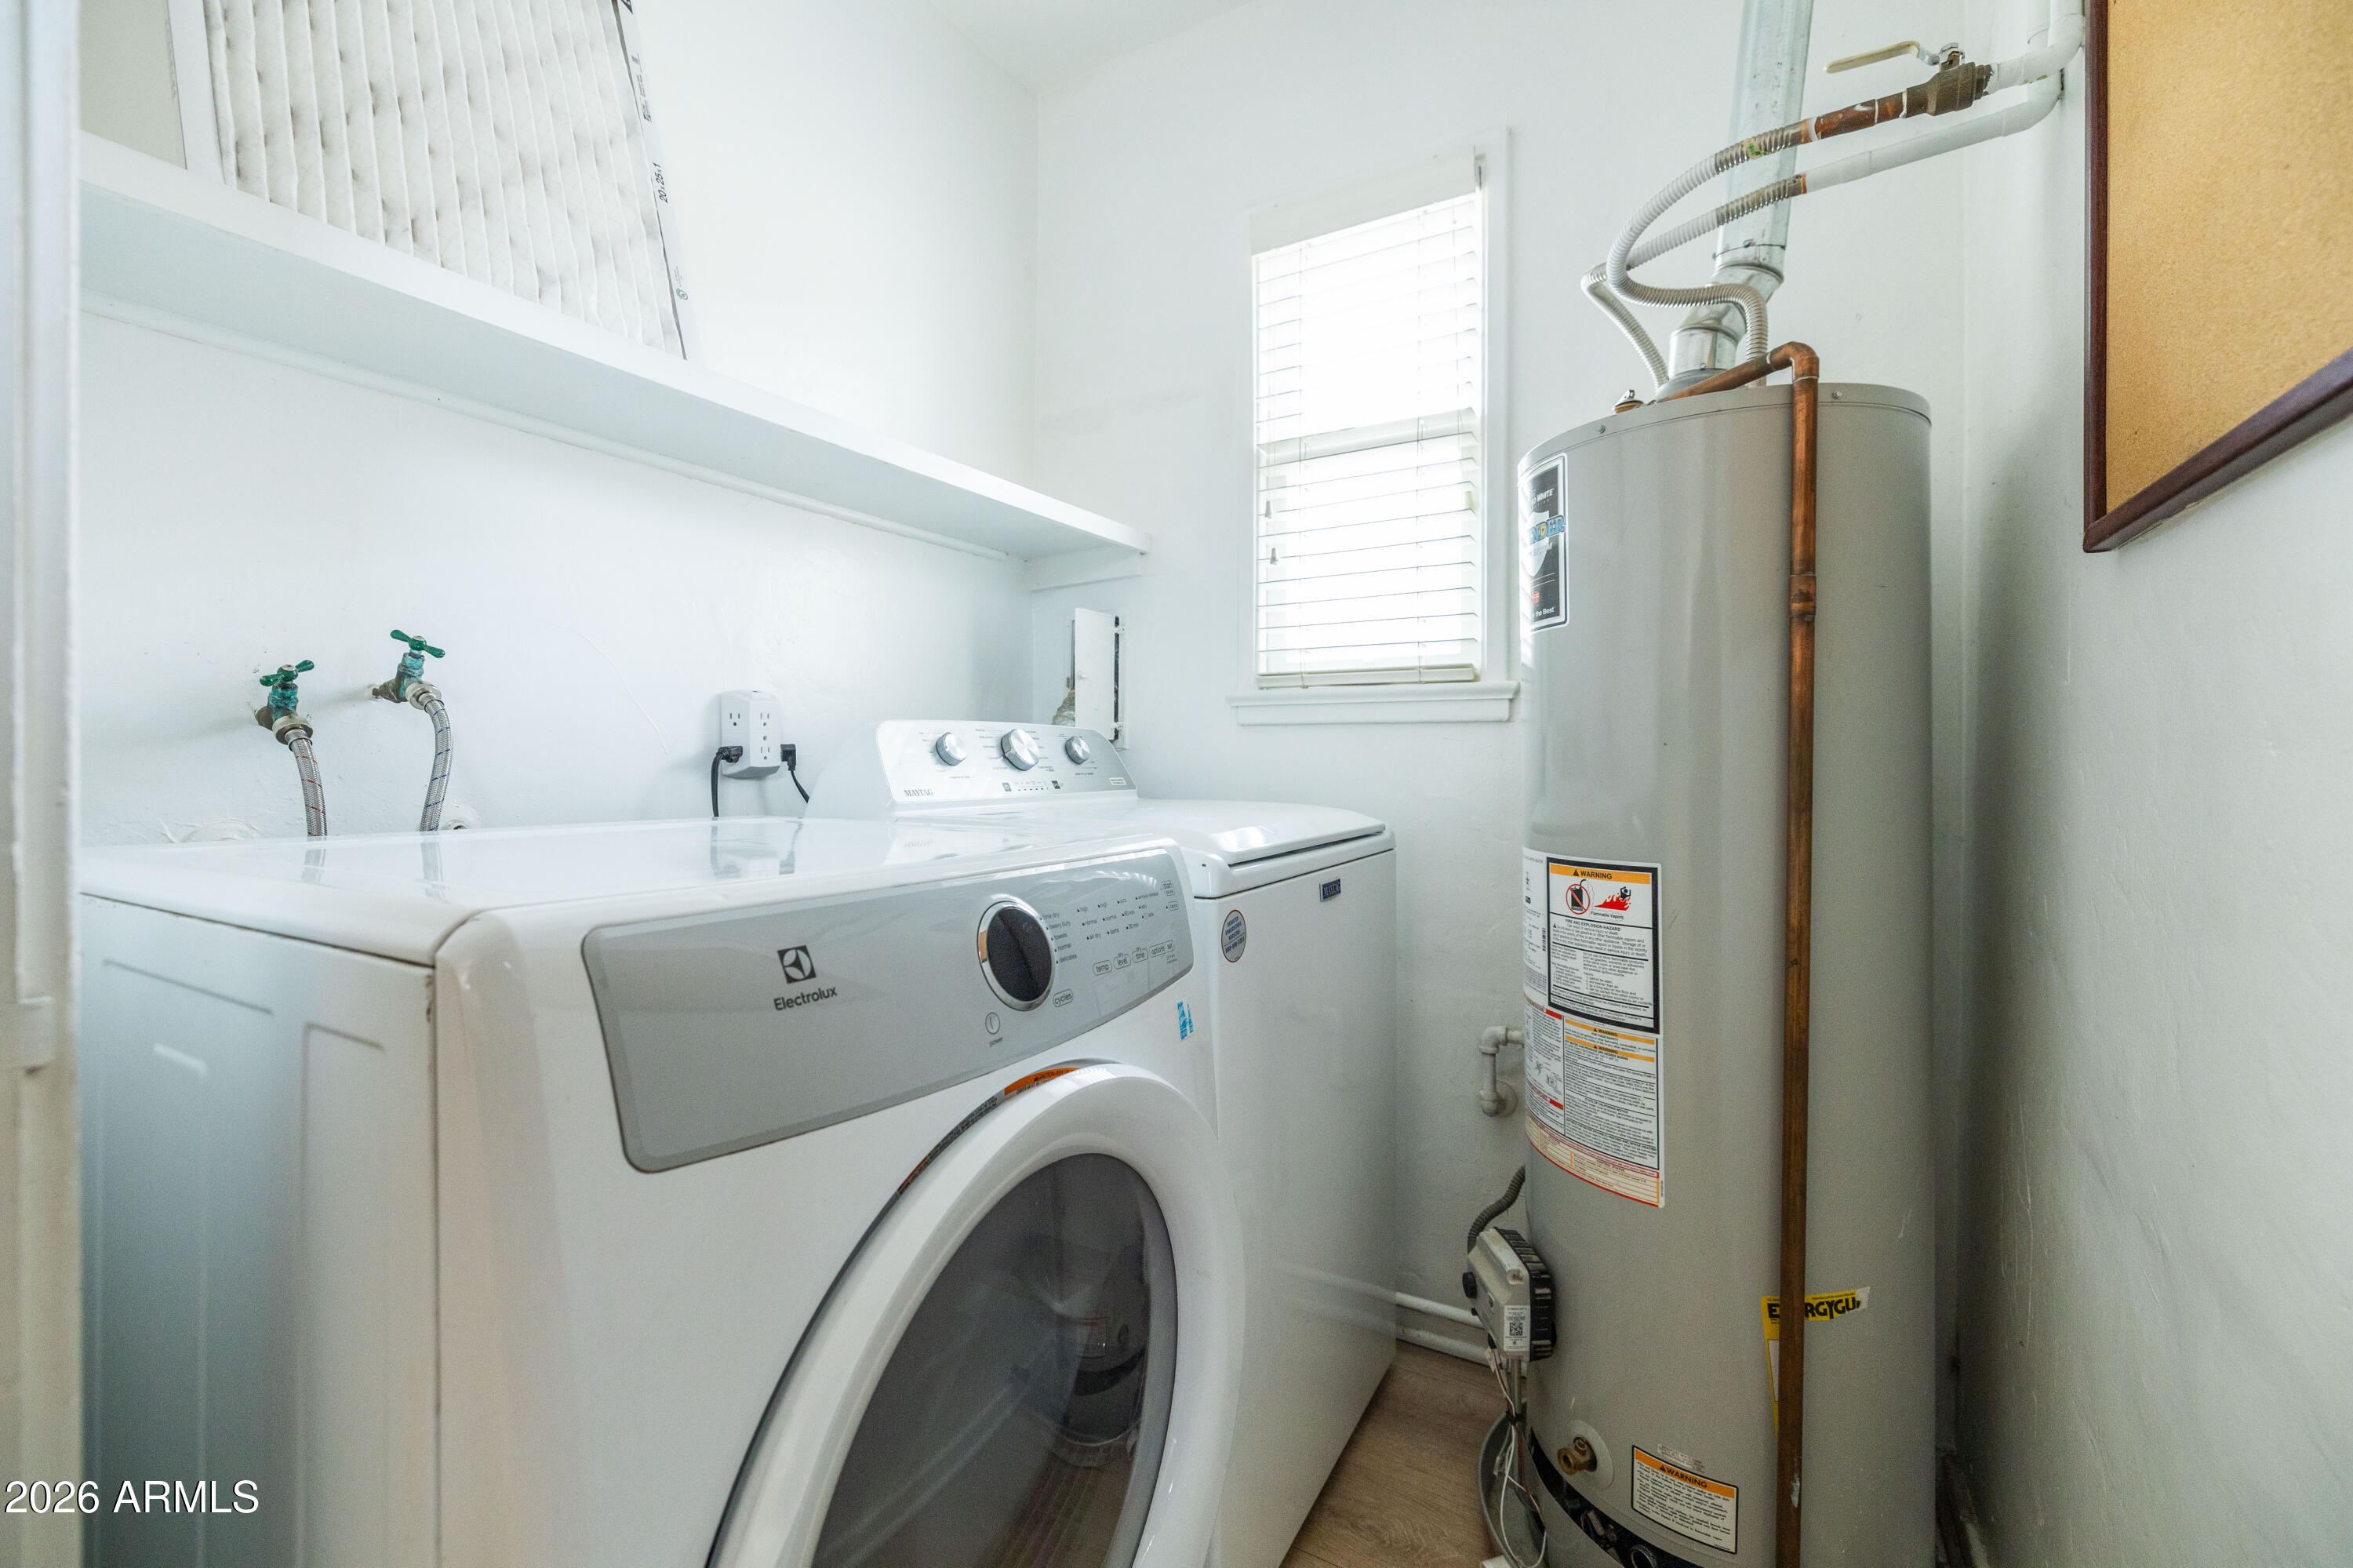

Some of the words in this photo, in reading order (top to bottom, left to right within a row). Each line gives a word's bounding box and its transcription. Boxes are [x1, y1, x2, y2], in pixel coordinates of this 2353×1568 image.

[1537, 489, 1554, 502] WHITE
[904, 788, 934, 797] MAYTAG
[1580, 870, 1613, 879] WARNING
[1151, 945, 1166, 955] options
[1117, 958, 1128, 966] level
[1096, 963, 1109, 973] temp
[773, 987, 838, 1011] Electrolux
[1054, 992, 1072, 1006] cycles
[1598, 1027, 1618, 1037] WARNING
[1598, 1044, 1618, 1054] WARNING
[1666, 1466, 1707, 1488] WARNING
